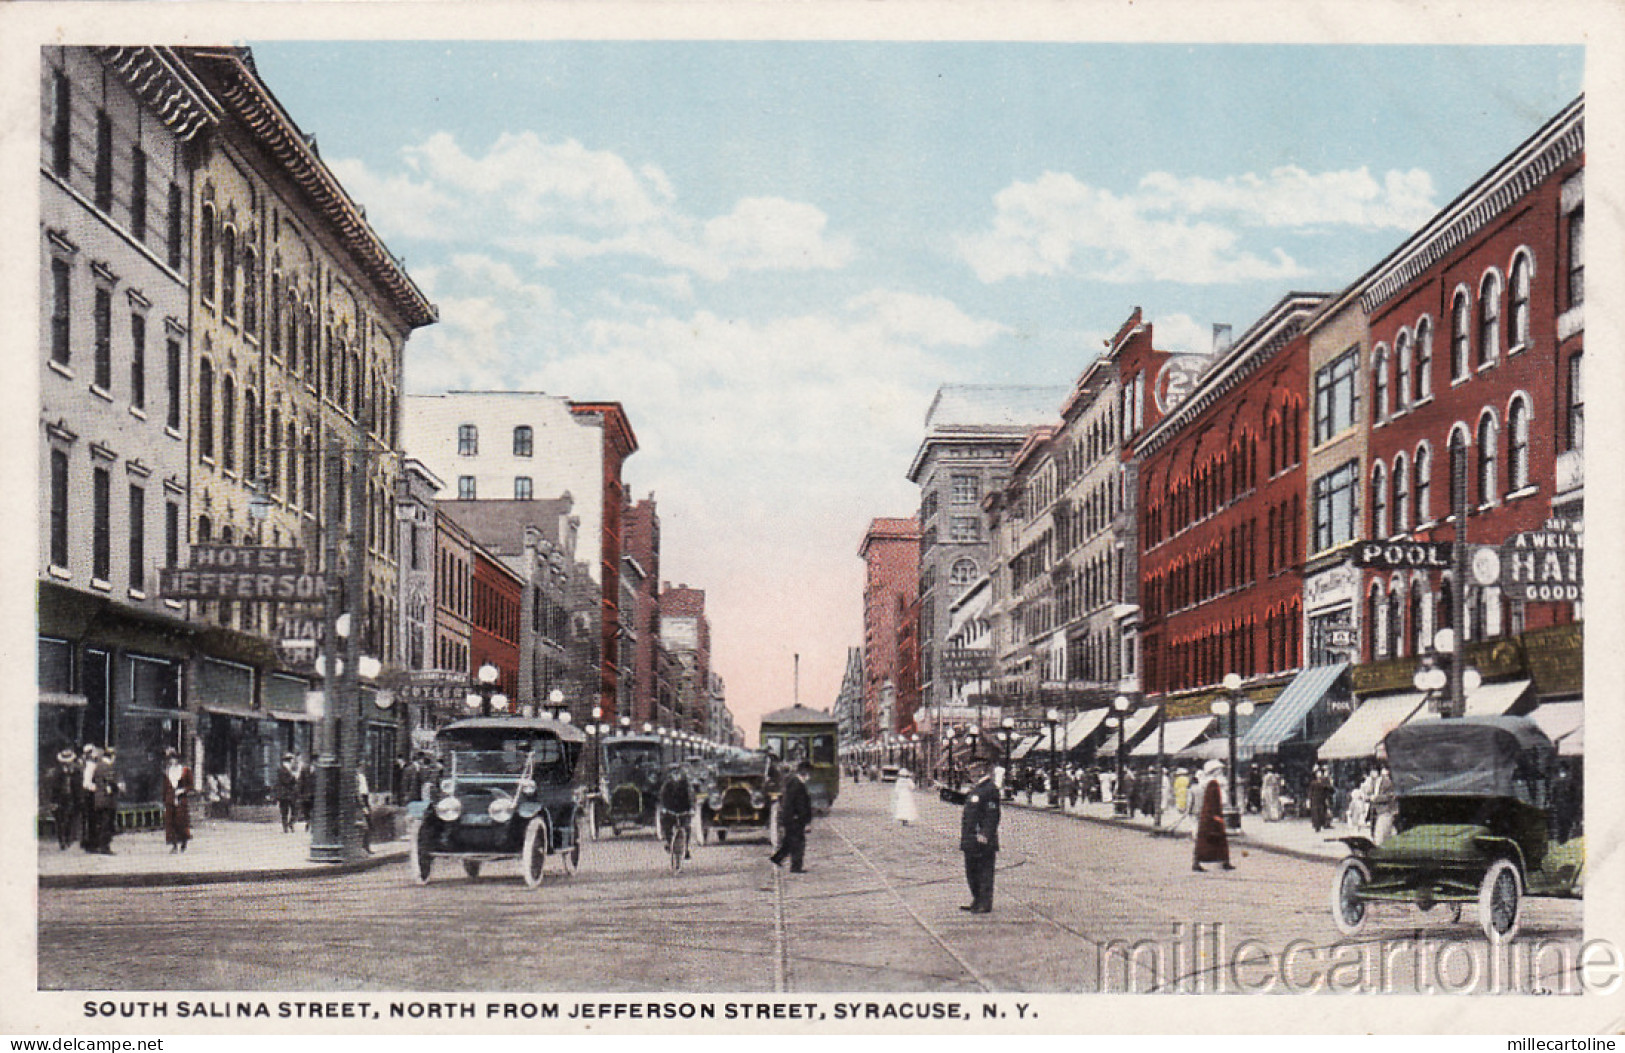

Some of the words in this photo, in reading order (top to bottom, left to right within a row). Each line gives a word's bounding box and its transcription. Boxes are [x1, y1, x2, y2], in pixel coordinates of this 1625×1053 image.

[1515, 533, 1527, 548] A
[198, 548, 296, 569] HOTEL
[1363, 544, 1447, 566] POOL
[1511, 550, 1578, 582] HAI
[164, 571, 328, 598] JEFFERSON
[1526, 585, 1583, 601] GOOD
